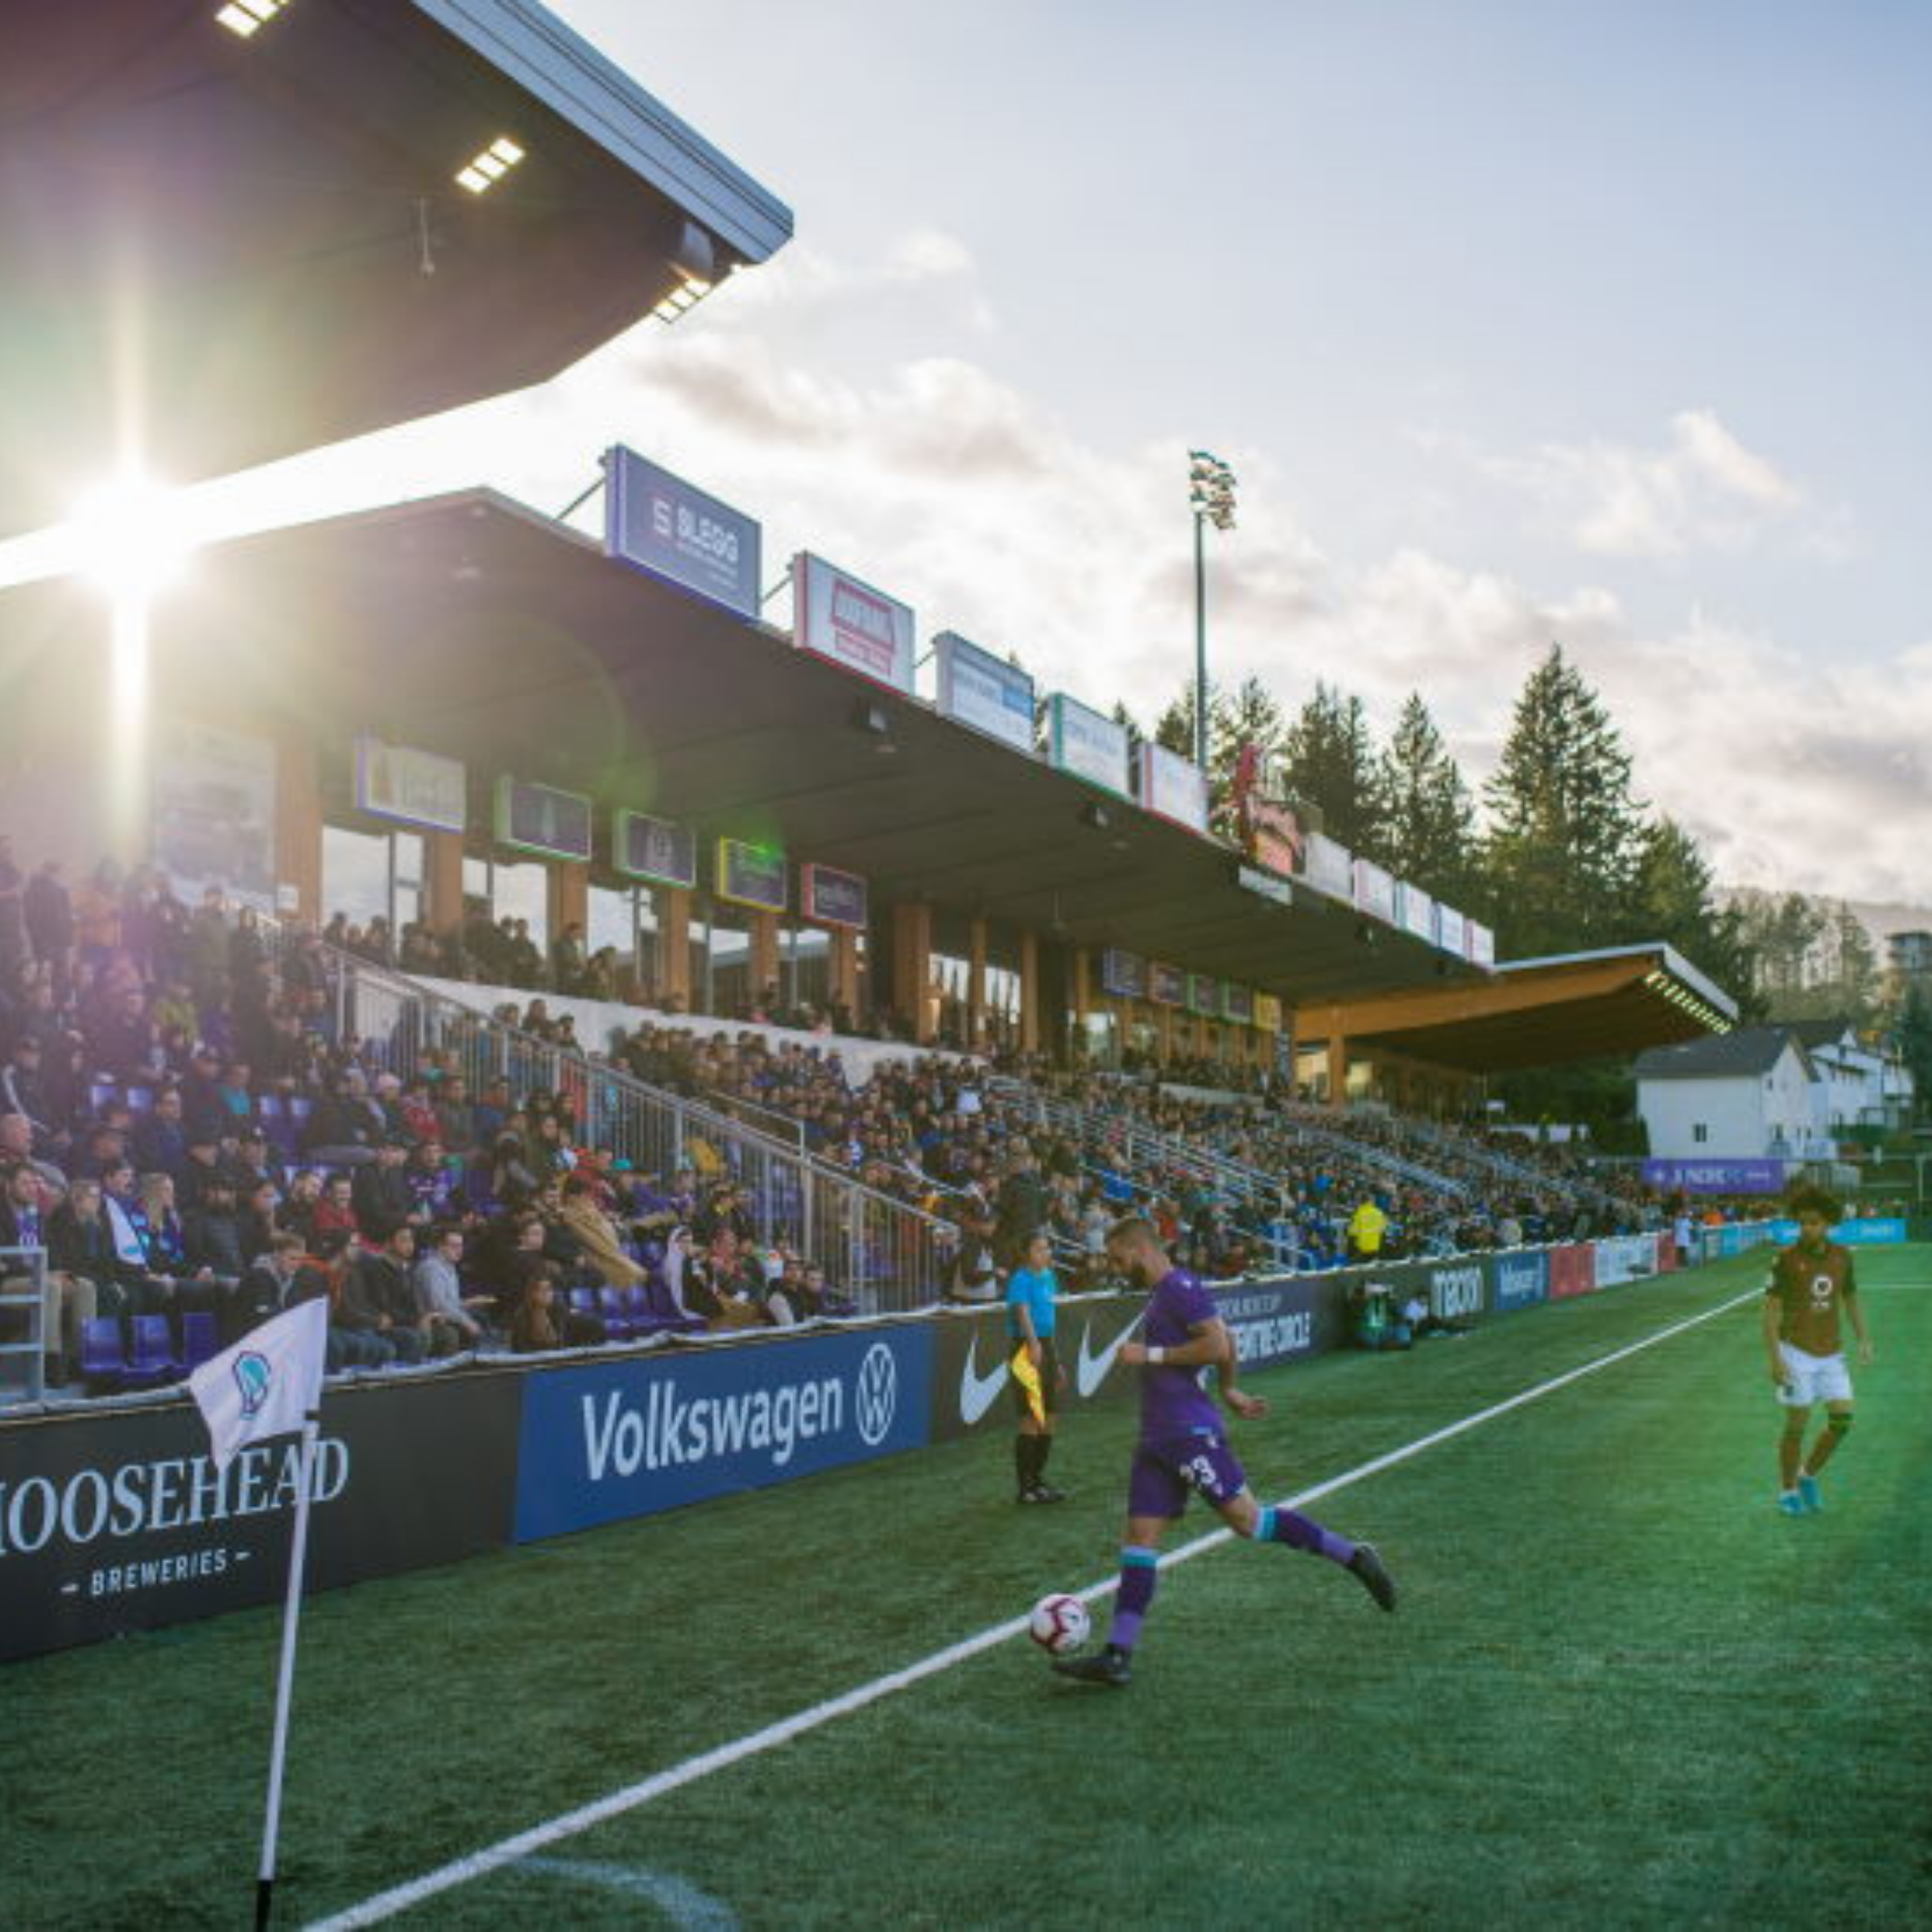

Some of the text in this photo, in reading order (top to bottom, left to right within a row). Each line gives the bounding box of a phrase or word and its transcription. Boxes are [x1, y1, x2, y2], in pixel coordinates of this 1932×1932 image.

[582, 1377, 844, 1481] Volkswagen
[0, 1438, 349, 1556] OOSEHEAD
[91, 1548, 228, 1596] BREWERIES
